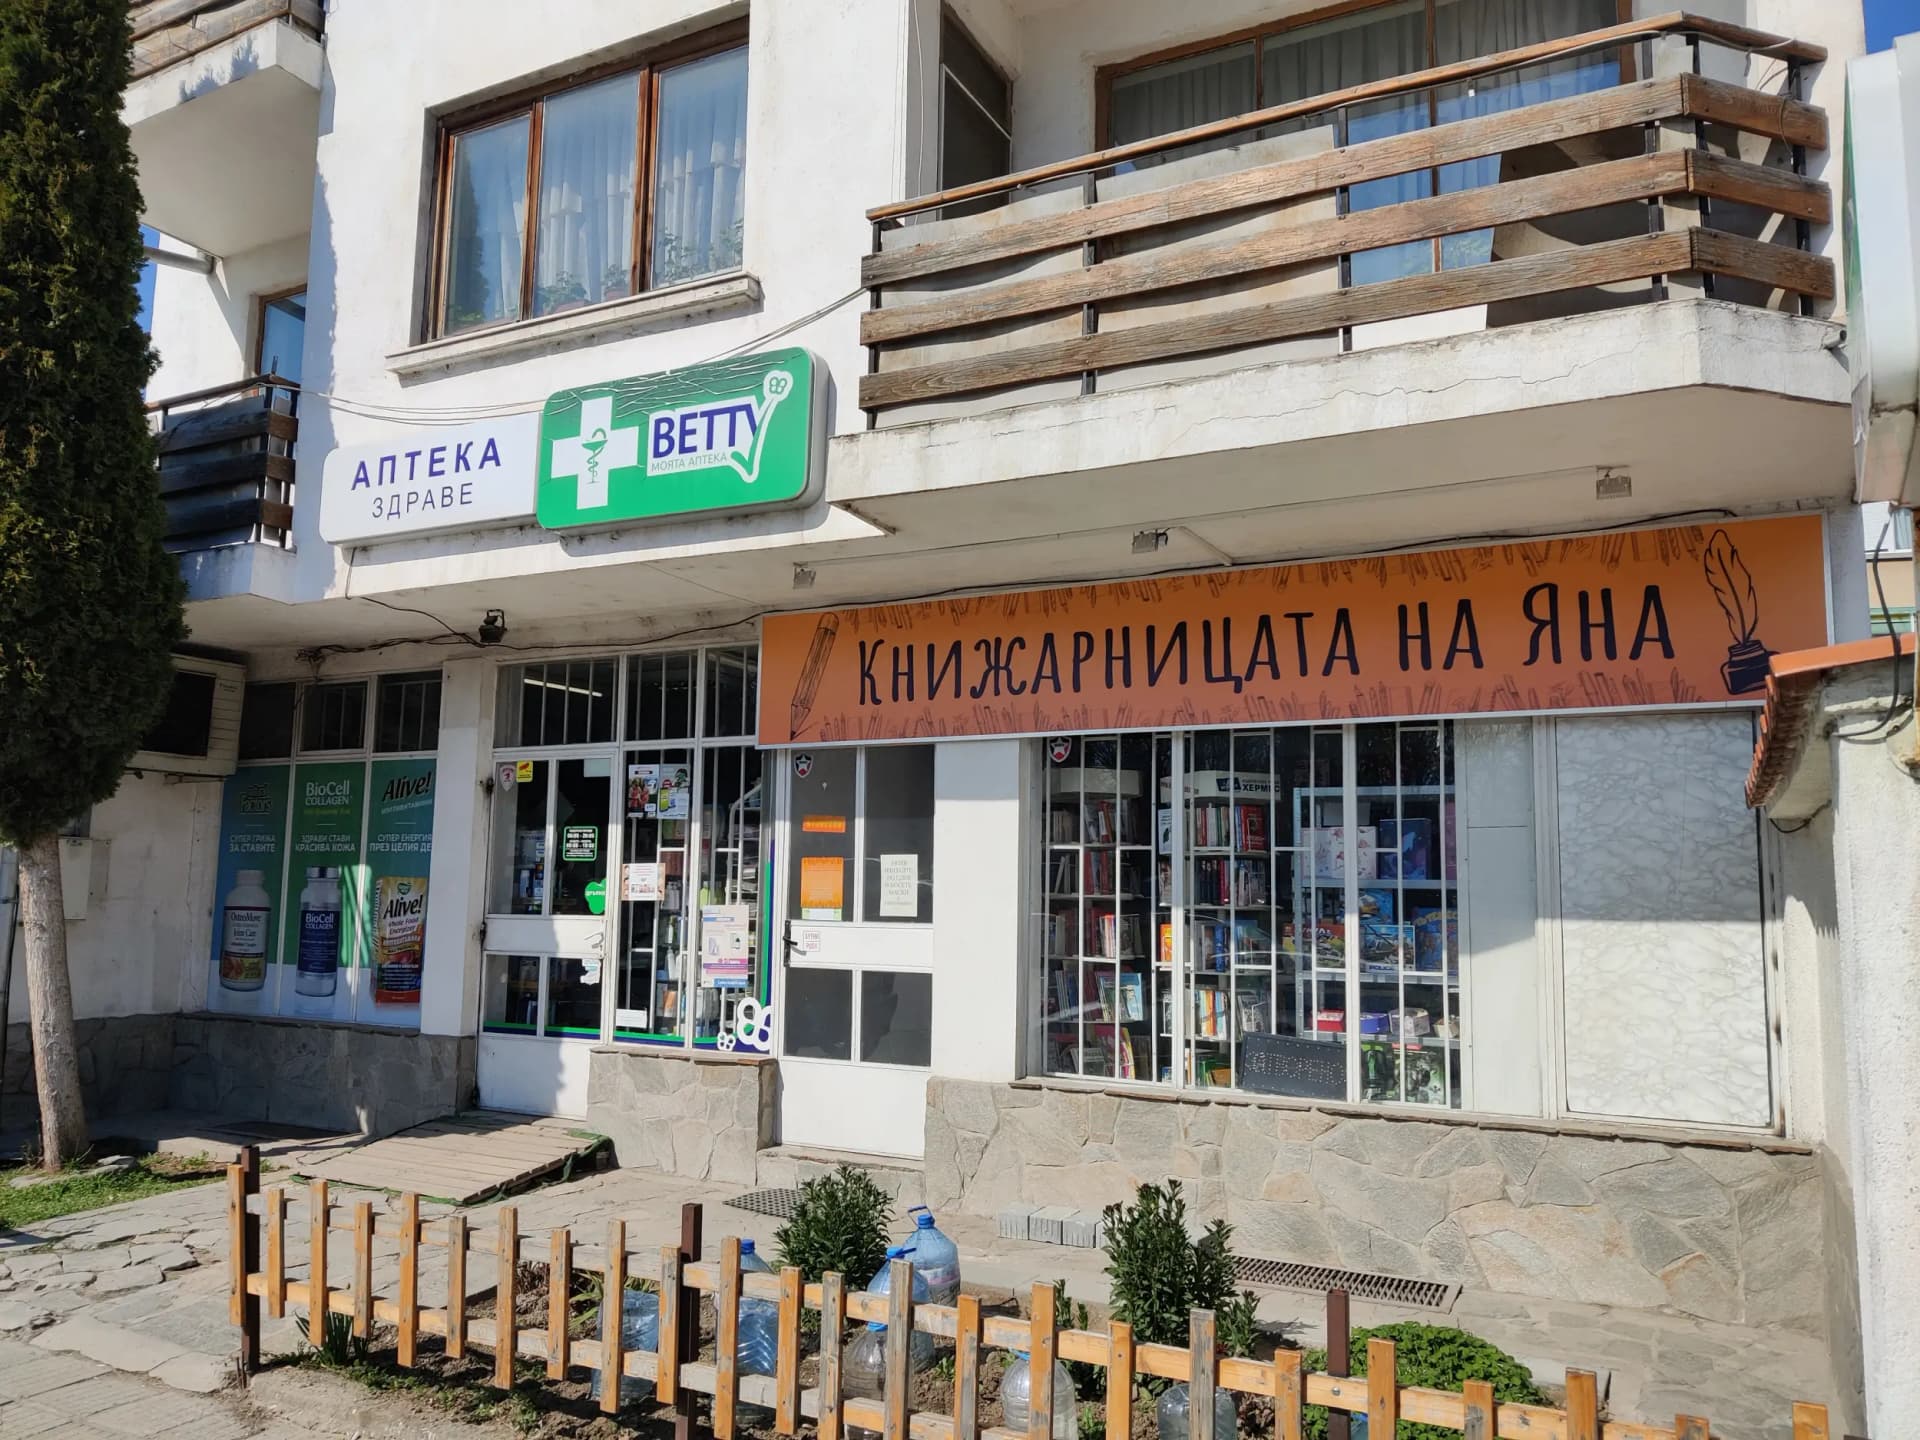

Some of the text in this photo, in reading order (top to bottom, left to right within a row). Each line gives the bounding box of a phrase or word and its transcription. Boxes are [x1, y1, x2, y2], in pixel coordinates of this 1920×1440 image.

[652, 390, 774, 464] BETTY
[351, 437, 502, 491] АПТЕКА
[651, 451, 727, 473] МОЯТА АПТЕКА
[371, 482, 474, 520] ЗДРАВЕ
[857, 582, 1675, 706] КНИЖАРНИЦАТА НА ЯНА
[305, 780, 350, 796] BioCell
[382, 772, 432, 802] Alive!
[1242, 783, 1280, 793] ХЕРМС
[304, 795, 350, 806] COLLAGEN
[377, 833, 400, 842] СУПЕР
[229, 843, 240, 852] ЗА
[369, 842, 390, 852] ПРЕЗ
[391, 842, 419, 854] ЦЕЛИЯ
[383, 894, 423, 919] Alive!
[305, 913, 334, 923] BioCell
